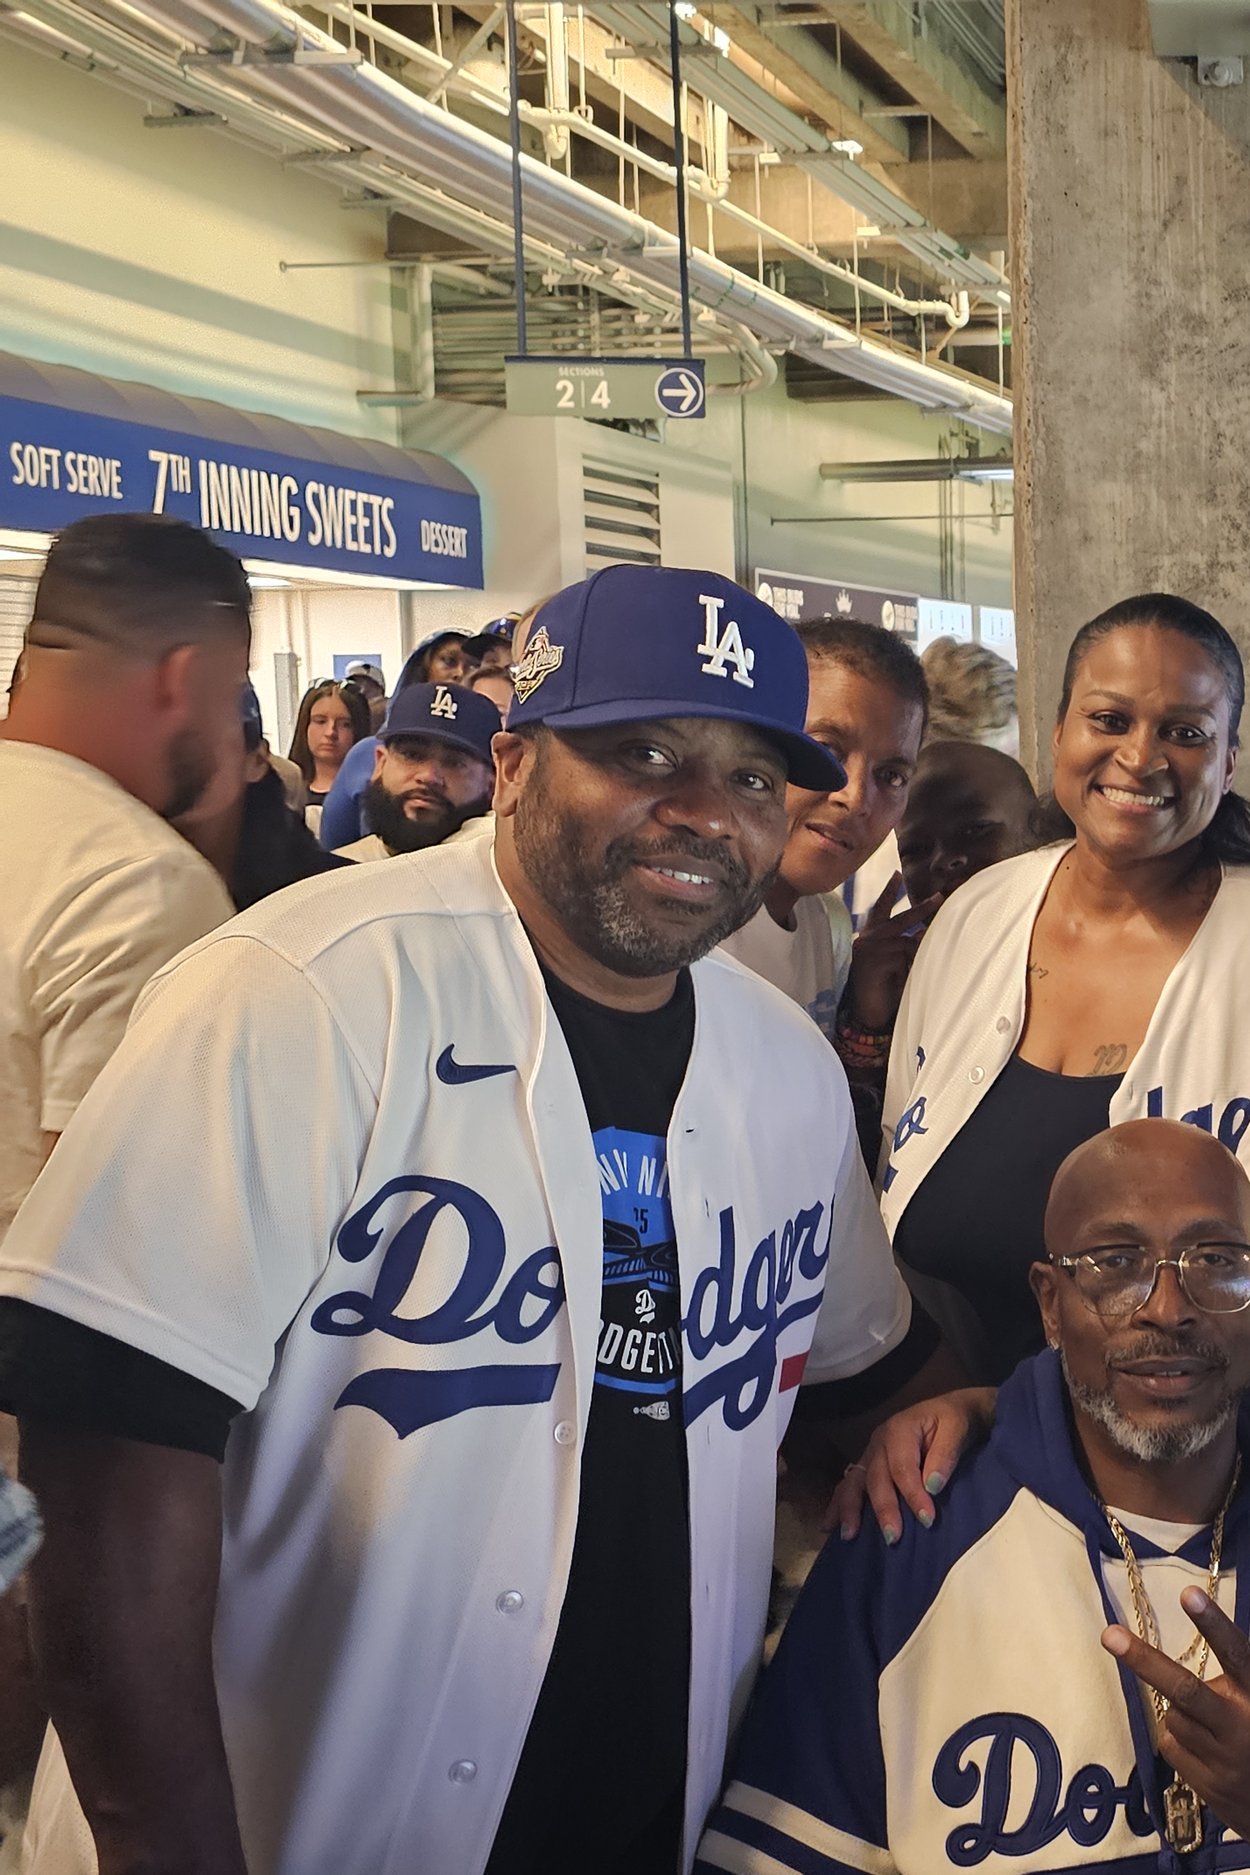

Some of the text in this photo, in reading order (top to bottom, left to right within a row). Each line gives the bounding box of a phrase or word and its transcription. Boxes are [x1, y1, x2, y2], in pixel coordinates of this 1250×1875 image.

[558, 367, 605, 377] SECTIONS
[556, 380, 611, 409] 2 4
[10, 441, 124, 500] SOFT SERVE
[148, 449, 397, 558] 7TH INNING SWEETS
[420, 519, 468, 558] DESSERT
[697, 594, 755, 688] LA
[430, 685, 458, 720] LA
